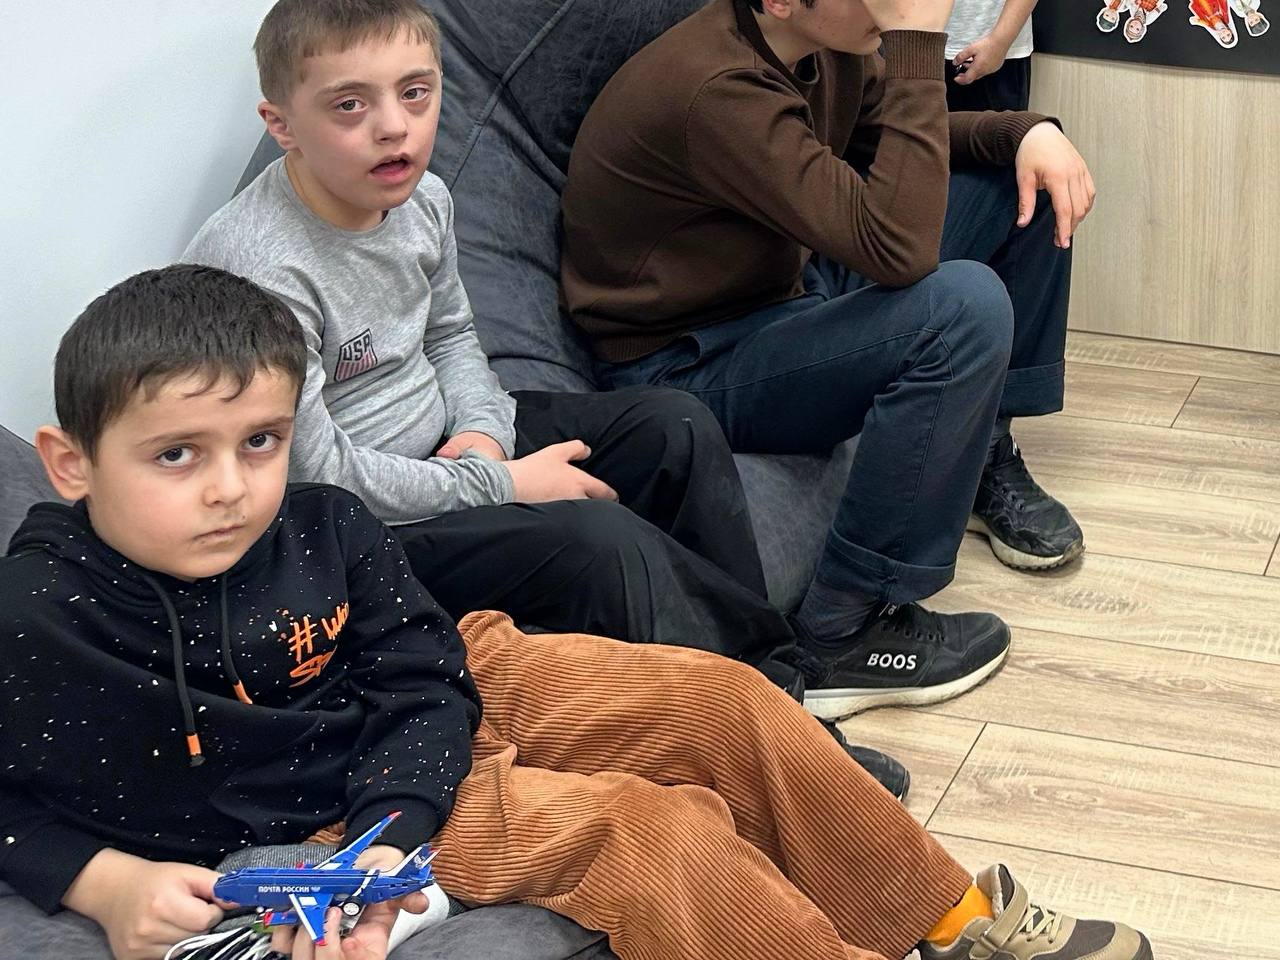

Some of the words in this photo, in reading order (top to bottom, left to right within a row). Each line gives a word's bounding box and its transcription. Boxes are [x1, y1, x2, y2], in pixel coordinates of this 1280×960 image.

[342, 334, 371, 361] USA
[867, 653, 917, 670] BOOS
[258, 885, 281, 893] ПОЧТА
